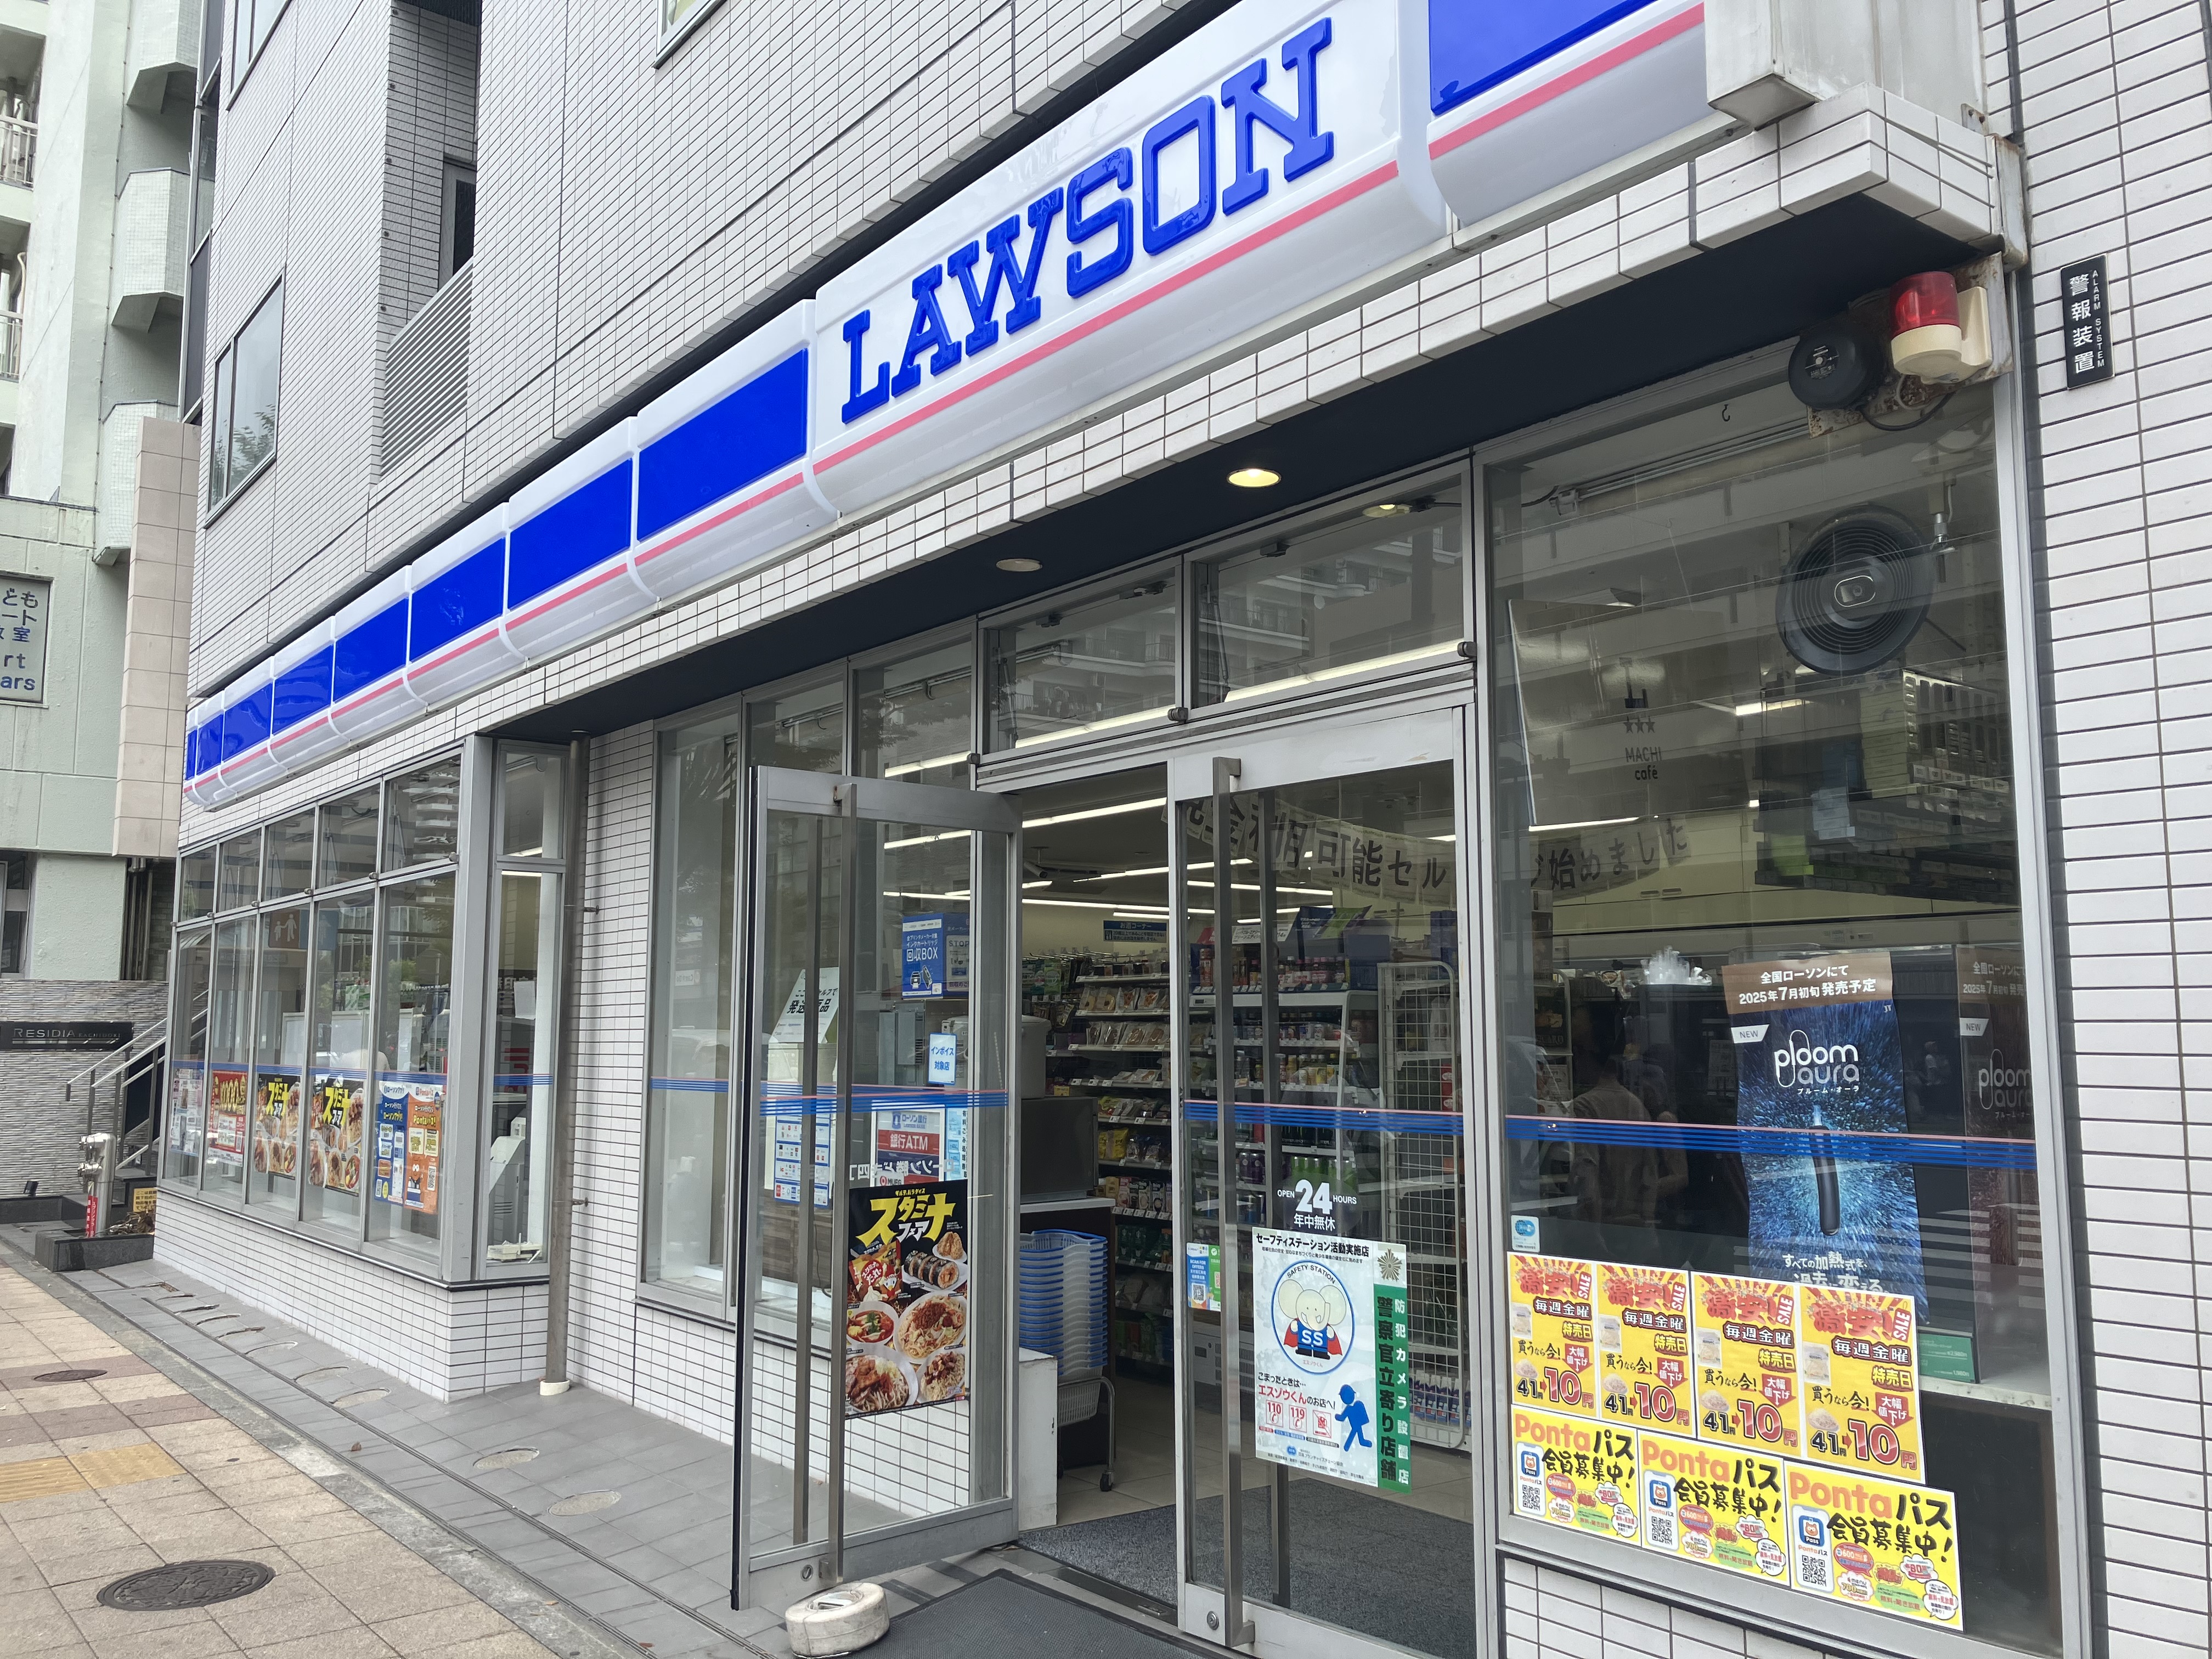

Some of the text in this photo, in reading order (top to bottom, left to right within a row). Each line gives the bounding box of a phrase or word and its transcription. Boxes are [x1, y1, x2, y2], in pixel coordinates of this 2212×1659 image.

[842, 17, 1334, 424] LAWSON
[2069, 273, 2095, 374] 警報装置
[2092, 270, 2105, 368] ALARM SYSTEM
[2, 588, 38, 608] ども
[1, 675, 35, 691] ars
[1624, 746, 1662, 763] MACHI
[1634, 765, 1658, 781] café
[906, 946, 938, 962] 回収BOX
[1760, 965, 1849, 984] 全国ローソンにて
[14, 1028, 75, 1038] RESIDIA
[1739, 1030, 1758, 1039] NEW
[1966, 1023, 1981, 1031] NEW
[930, 1046, 955, 1057] インボイス
[1774, 1029, 1859, 1088] ploom
[934, 1060, 950, 1071] 対象店
[1797, 1064, 1859, 1085] aura
[1797, 1085, 1860, 1095] プルーム・オーラ
[902, 1114, 927, 1124] ローソン銀行
[890, 1133, 928, 1150] 銀行ATM
[1277, 1179, 1357, 1215] OPEN 24 HOURS
[856, 1193, 956, 1248] スタミナ
[1294, 1213, 1336, 1232] 年中無休
[895, 1220, 930, 1243] フェア
[1256, 1233, 1369, 1257] セーフティステーション活動実施店
[1782, 1251, 1868, 1272] すべての加熱式を、
[1287, 1264, 1336, 1284] SAFETY STATION
[1578, 1273, 1592, 1300] SALE
[1671, 1283, 1686, 1311] SALE
[1535, 1299, 1590, 1318] 毎週金曜
[1778, 1296, 1793, 1325] SALE
[1624, 1311, 1685, 1331] 毎週金曜
[1893, 1311, 1911, 1341] SALE
[1301, 1329, 1323, 1346] SS
[1562, 1322, 1593, 1341] 特売日
[1725, 1324, 1792, 1346] 毎週金曜
[1518, 1340, 1561, 1361] 買うなら今!
[1570, 1346, 1585, 1357] 大幅
[1654, 1334, 1687, 1355] 特売日
[1834, 1339, 1910, 1364] 毎週金曜
[1567, 1355, 1588, 1369] 値下げ
[1606, 1353, 1653, 1375] 買うなら今!
[1662, 1361, 1679, 1372] 大幅
[1758, 1350, 1796, 1372] 特売日
[1659, 1370, 1683, 1384] 値下げ
[1704, 1368, 1757, 1391] 買うなら今!
[1767, 1377, 1786, 1390] 大幅
[1871, 1366, 1913, 1391] 特売日
[1377, 1295, 1397, 1482] 警察官立寄り店舗
[1395, 1298, 1409, 1486] 防犯カメラ設置店
[1517, 1367, 1594, 1409] 41円 10円
[1764, 1386, 1791, 1402] 値下げ
[1267, 1402, 1282, 1414] 110
[1605, 1383, 1690, 1426] 41円 10円
[1812, 1386, 1870, 1411] 買うなら今!
[1881, 1395, 1903, 1408] 大幅
[1290, 1407, 1305, 1420] 119
[1703, 1399, 1798, 1447] 41円 10円
[1878, 1406, 1908, 1423] 値下げ
[1515, 1414, 1634, 1462] Pontaパス
[1810, 1419, 1917, 1471] 41円 10円
[1541, 1447, 1635, 1488] 会員募集中!
[1643, 1441, 1781, 1493] Pontaパス
[1520, 1476, 1542, 1486] Pontaパス
[1655, 1498, 1667, 1506] Pass
[1673, 1476, 1782, 1523] 会員募集中!
[1790, 1471, 1951, 1531] Pontaパス
[1649, 1507, 1674, 1518] Pontaパス
[1806, 1535, 1819, 1544] Pass
[1827, 1512, 1953, 1563] 会員募集中!
[1798, 1544, 1828, 1556] Pontaパス
